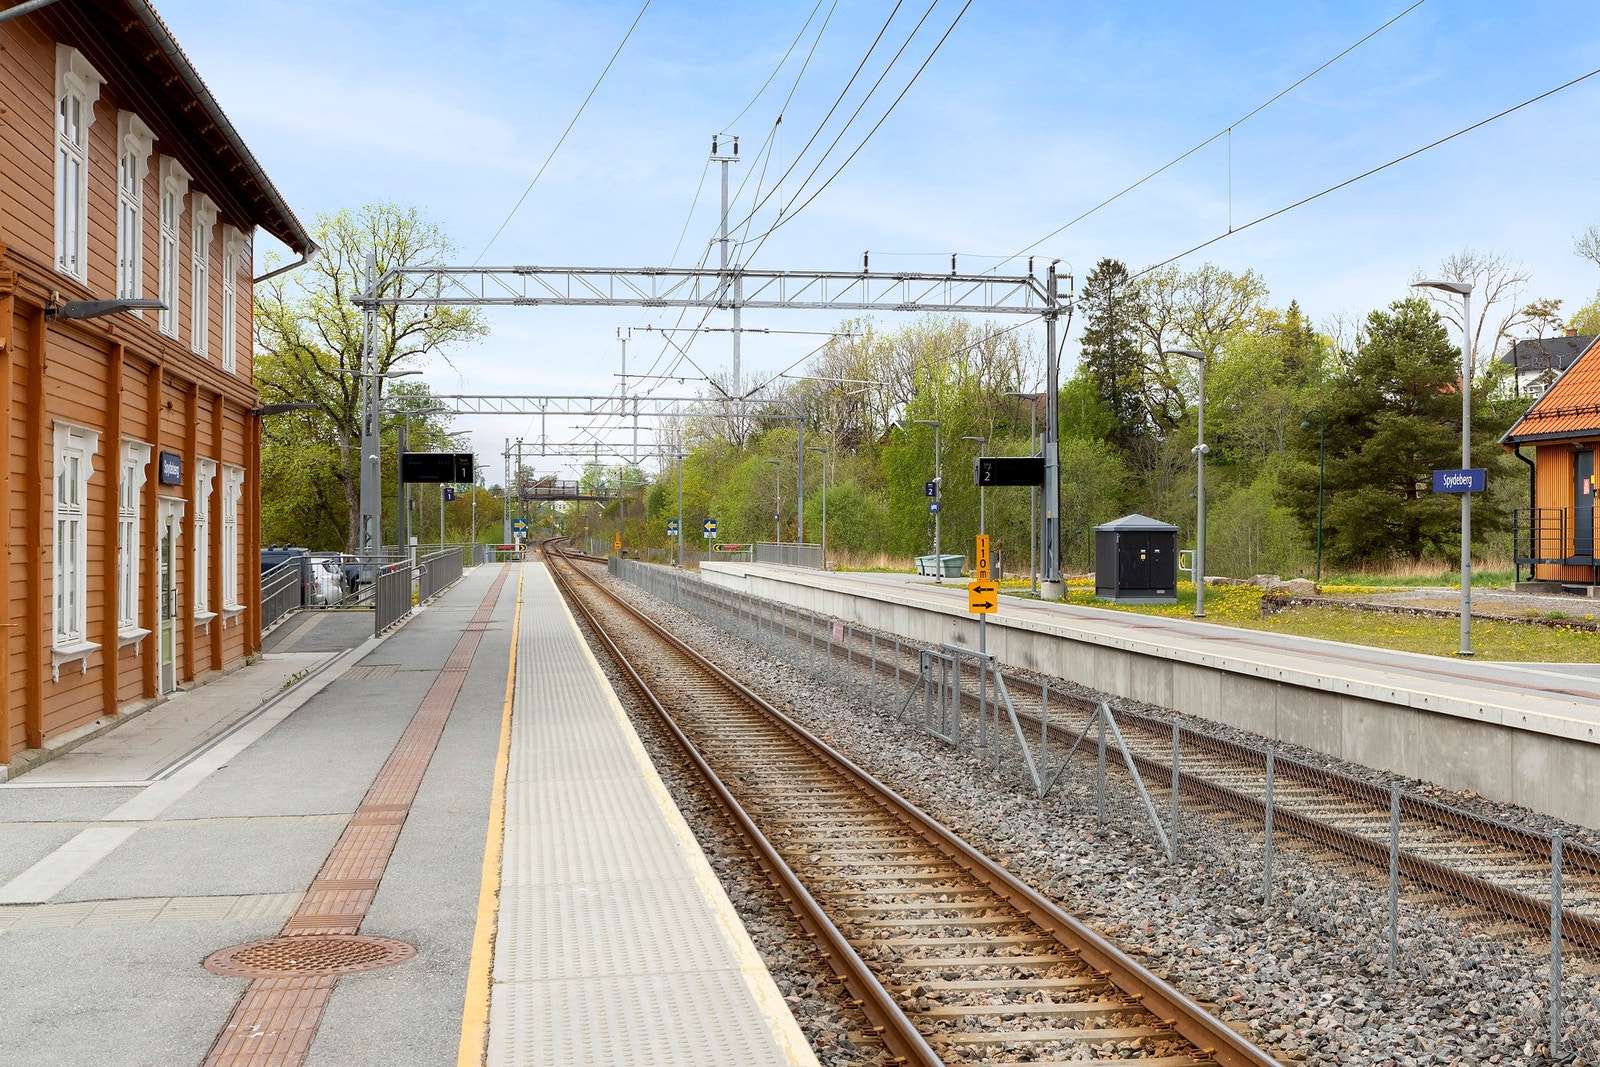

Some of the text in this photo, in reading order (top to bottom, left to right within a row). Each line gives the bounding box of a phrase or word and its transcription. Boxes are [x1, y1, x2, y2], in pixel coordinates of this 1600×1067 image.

[462, 467, 466, 478] 1
[984, 471, 991, 481] 2
[1443, 473, 1472, 488] Spydeberg
[928, 488, 933, 496] 2
